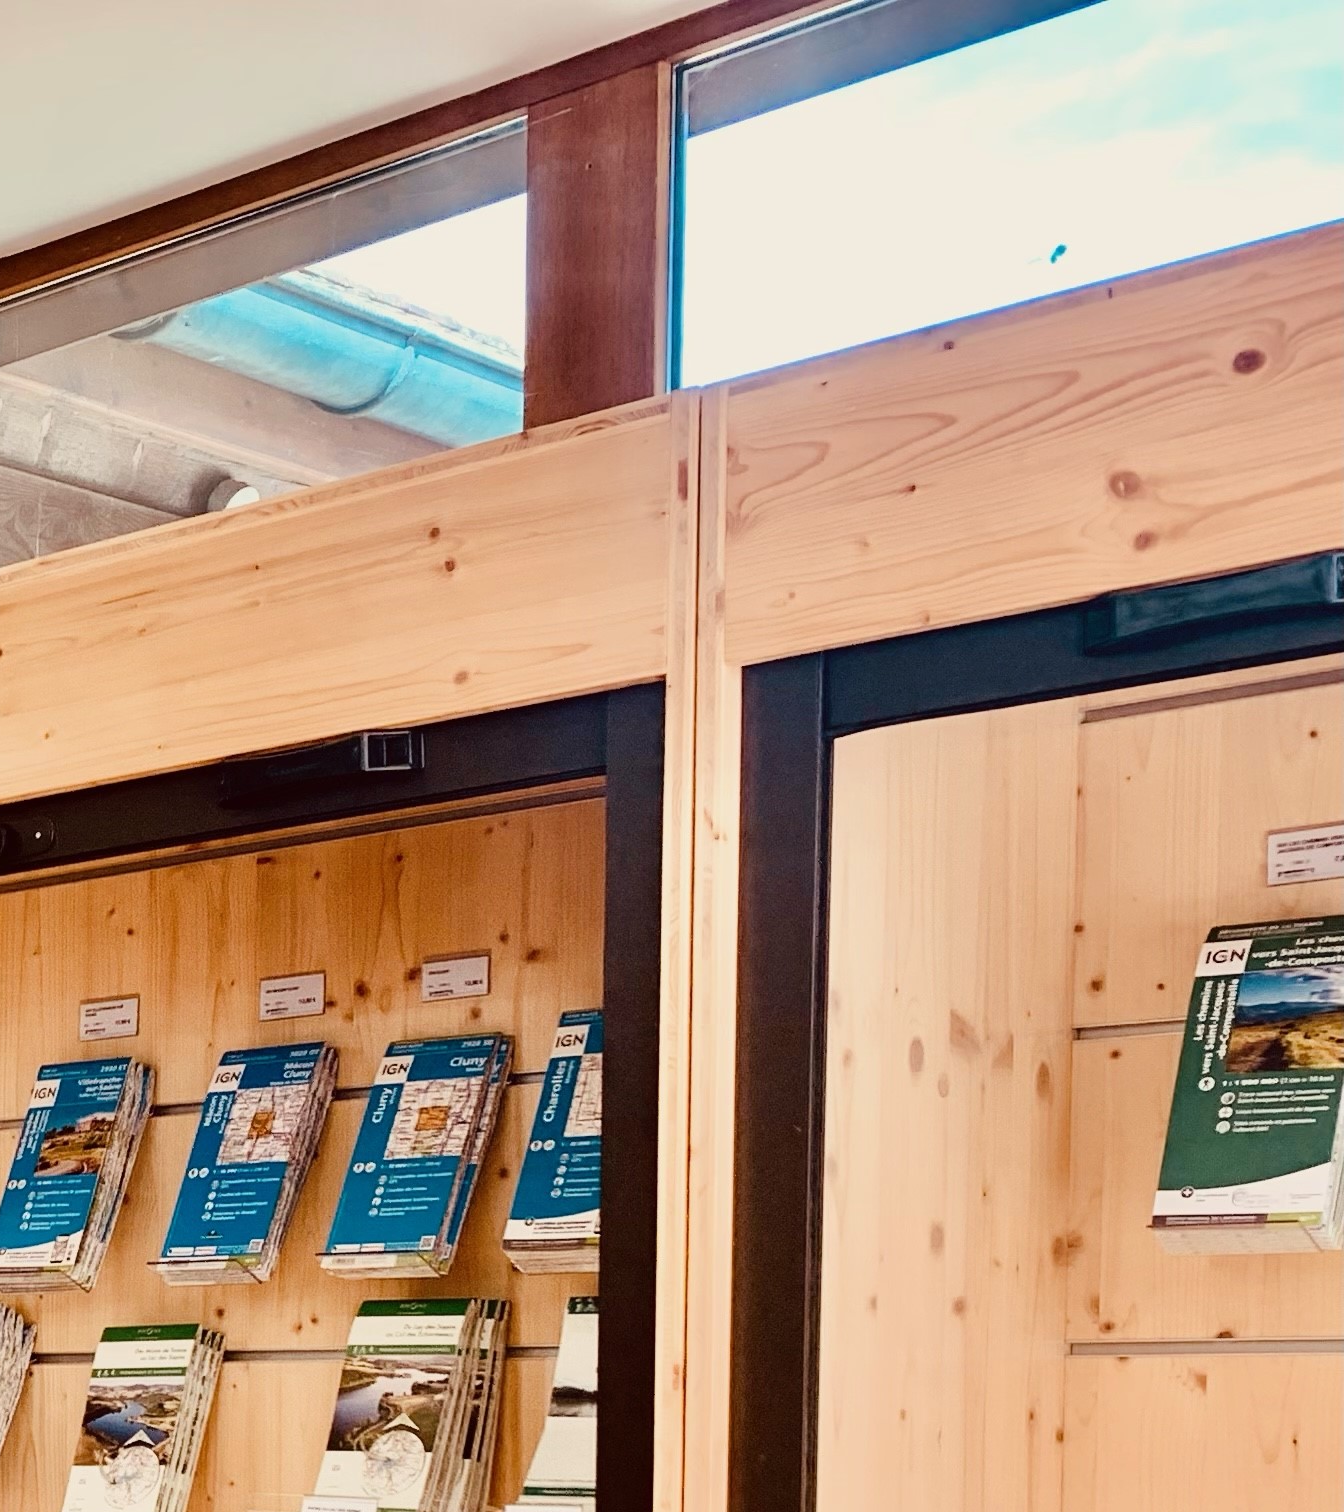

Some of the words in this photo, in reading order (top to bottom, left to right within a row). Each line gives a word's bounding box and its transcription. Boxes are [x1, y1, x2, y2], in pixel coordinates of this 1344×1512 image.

[1296, 937, 1315, 946] Les
[1206, 948, 1246, 964] IGN
[1252, 951, 1277, 960] vers
[1265, 955, 1344, 968] -de-Compost
[555, 1033, 585, 1048] IGN
[449, 1056, 488, 1067] Cluny
[283, 1070, 312, 1079] Cluny
[382, 1063, 409, 1075] IGN
[215, 1071, 242, 1084] IGN
[34, 1087, 57, 1099] IGN
[543, 1060, 567, 1123] Charolles
[372, 1087, 392, 1124] Cluny
